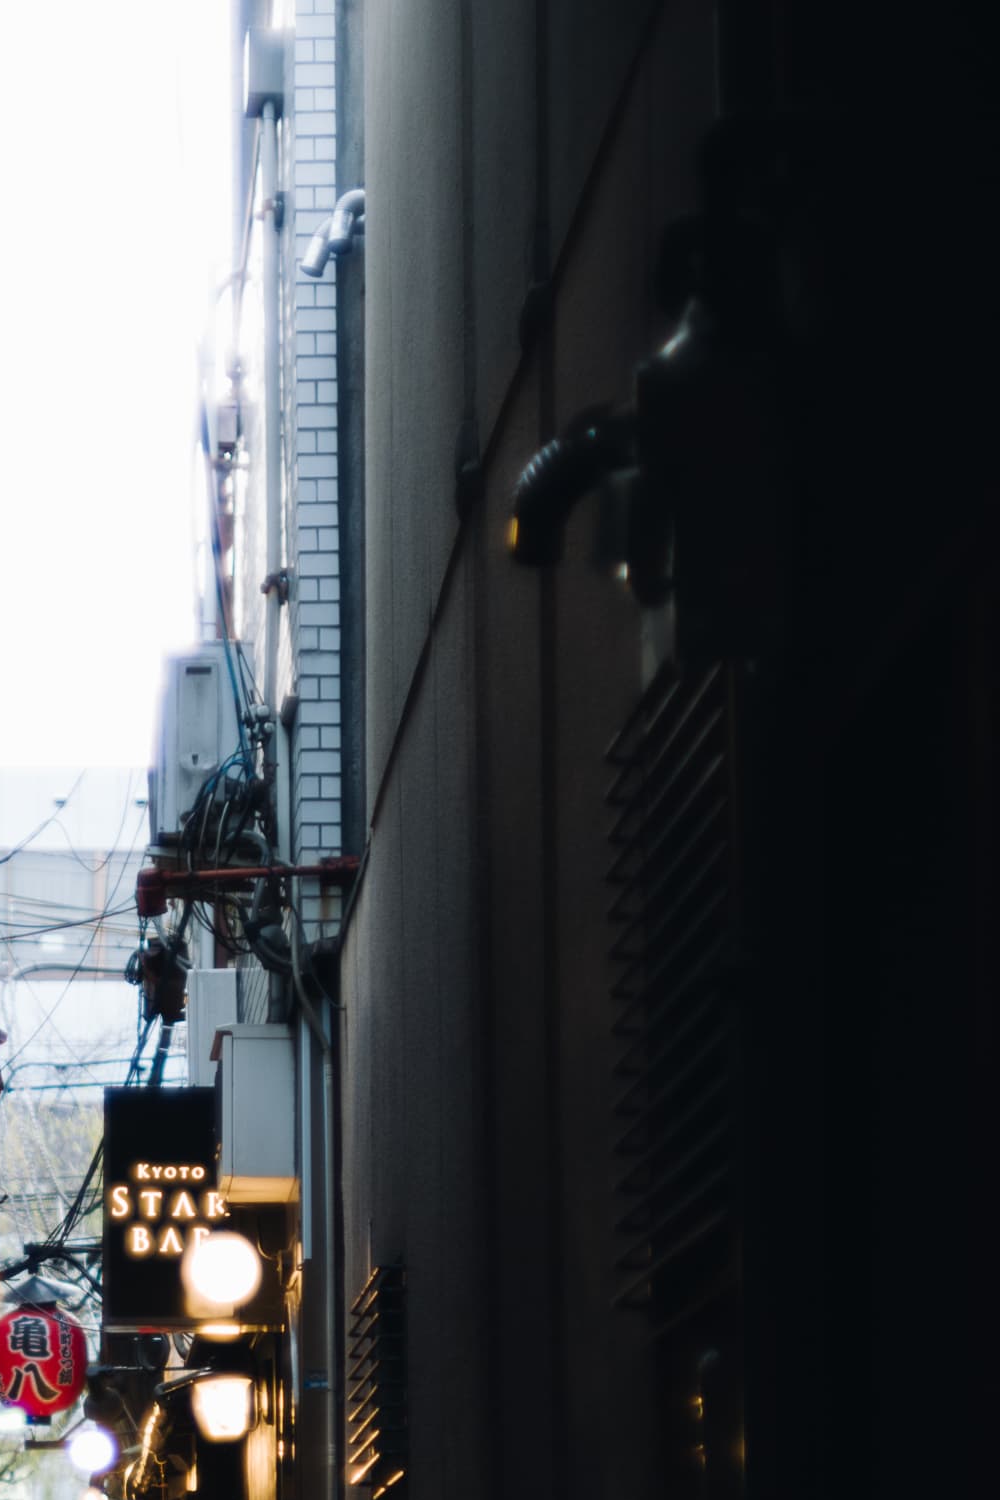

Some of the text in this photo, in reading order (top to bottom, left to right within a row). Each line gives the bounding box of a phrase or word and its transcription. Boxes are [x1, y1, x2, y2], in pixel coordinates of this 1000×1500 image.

[137, 1164, 205, 1179] KYOTO
[112, 1186, 230, 1217] STAR
[8, 1315, 60, 1402] 亀八
